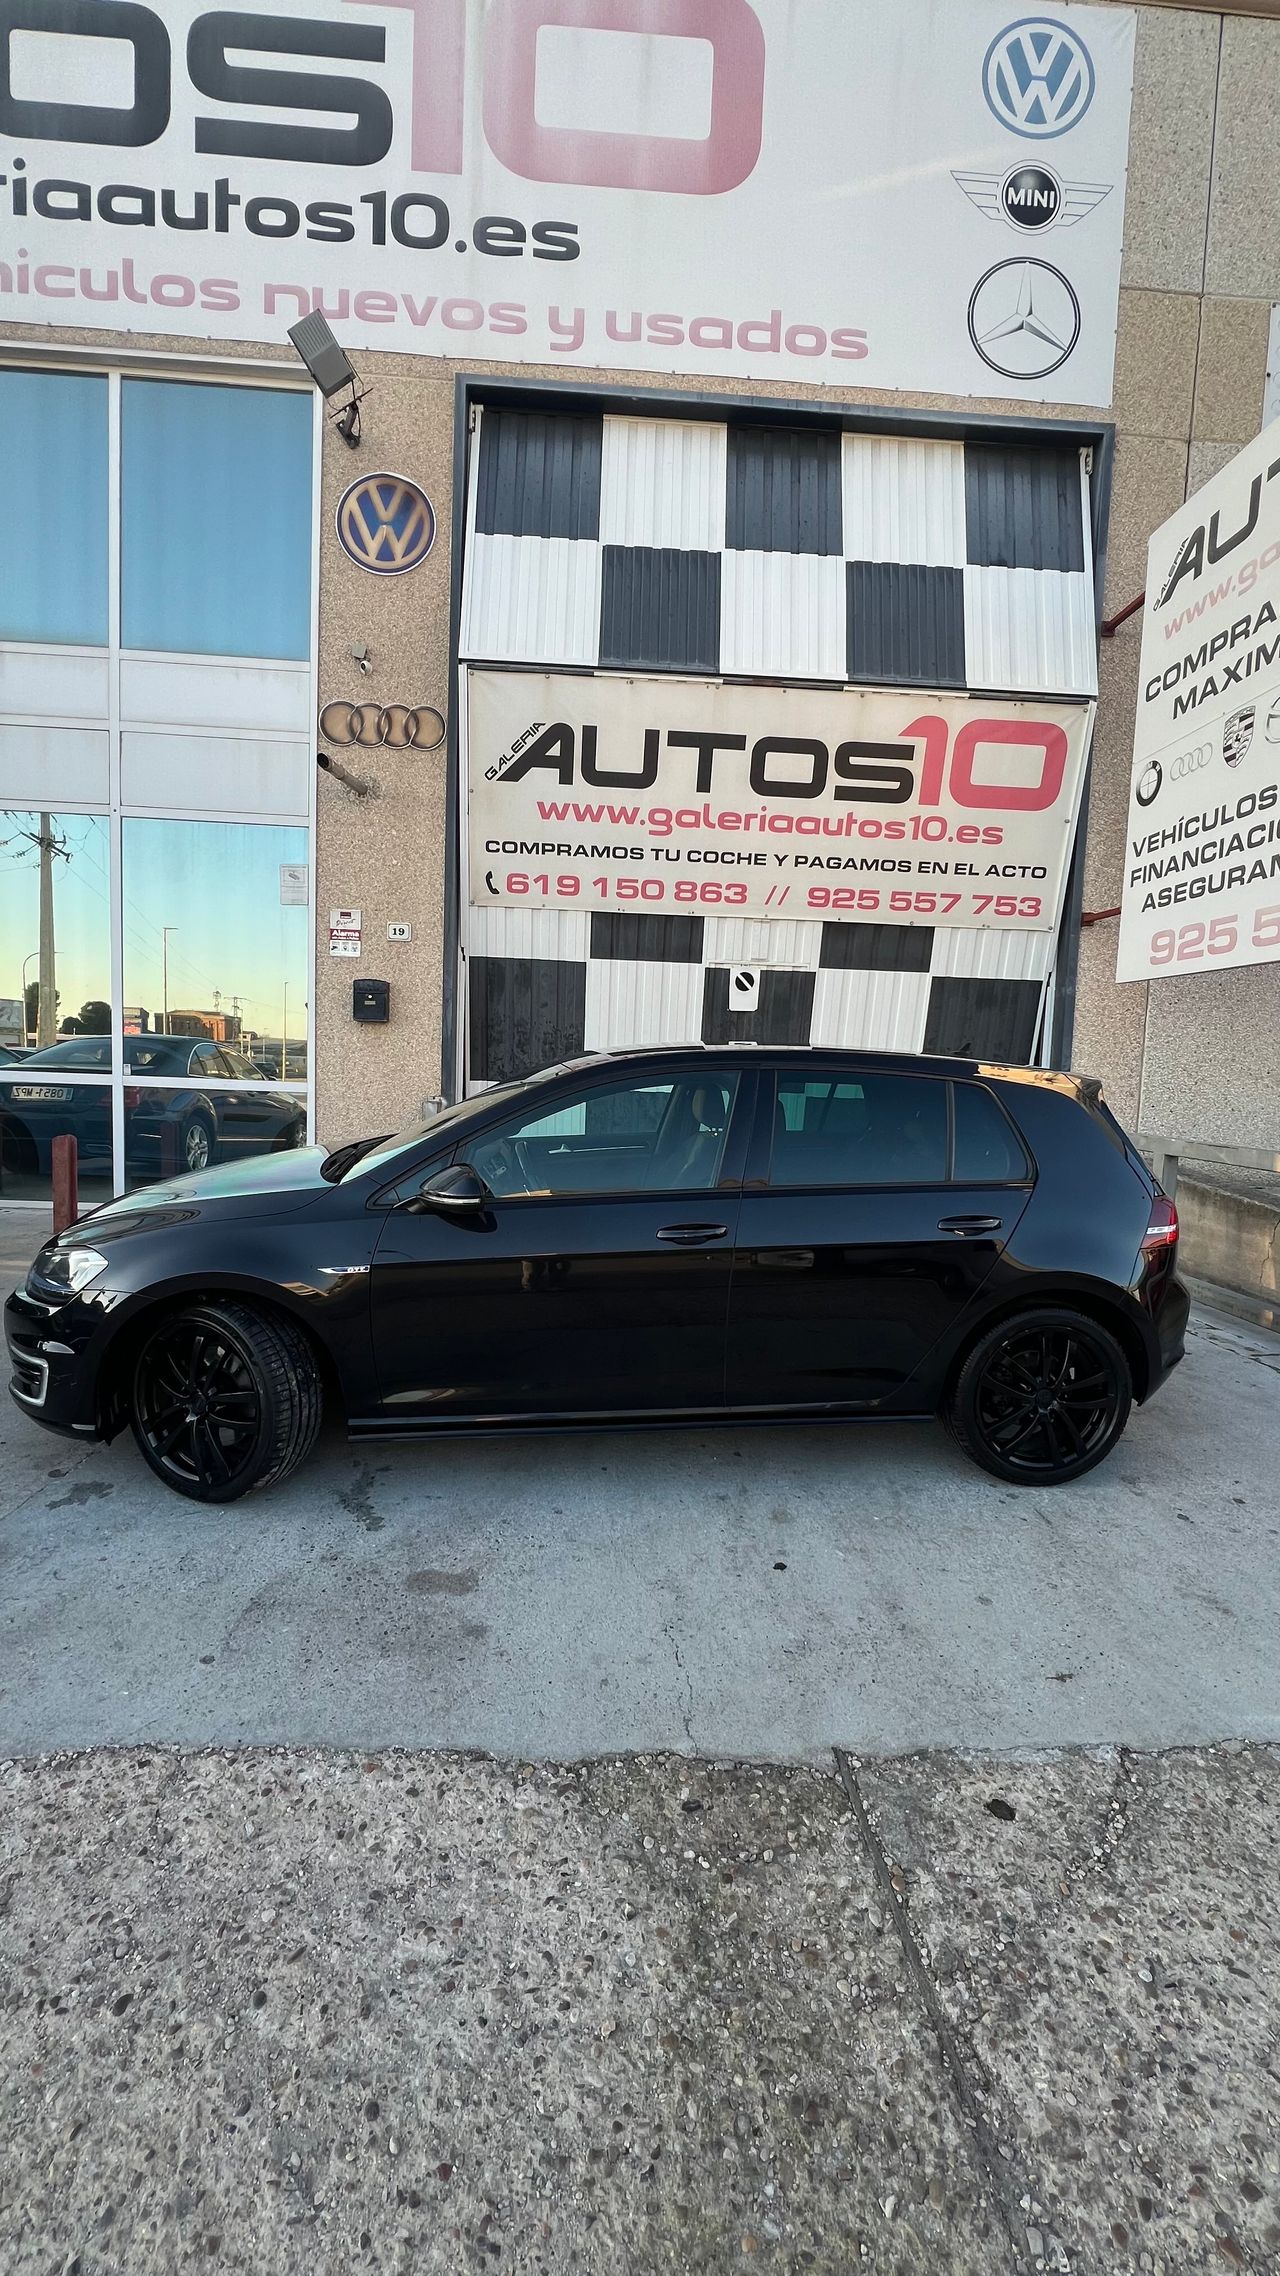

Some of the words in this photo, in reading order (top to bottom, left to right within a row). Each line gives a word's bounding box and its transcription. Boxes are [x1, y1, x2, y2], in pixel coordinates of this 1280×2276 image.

[0, 157, 580, 261] iaautos10.es
[1007, 187, 1056, 208] MINI
[264, 281, 528, 335] nuevos
[549, 305, 585, 351] y
[604, 309, 869, 360] usados
[1153, 537, 1189, 612] GALERIA
[1145, 600, 1278, 703] COMPRA
[484, 722, 546, 781] GALERIA
[536, 801, 1004, 845] www.galeriaautos10.es
[1132, 784, 1278, 858] VEHÍCULOS
[485, 840, 645, 860] COMPRAMOS
[650, 848, 681, 862] TU
[687, 850, 768, 866] COCHE
[773, 854, 789, 867] Y
[794, 855, 912, 873] PAGAMOS
[917, 861, 949, 875] EN
[954, 864, 980, 876] EL
[985, 864, 1048, 879] ACTO
[1130, 820, 1280, 888] FINANCIACI
[506, 872, 580, 897] 619
[592, 877, 665, 900] 150
[674, 881, 748, 904] 863
[806, 886, 881, 911] 925
[888, 890, 962, 914] 557
[972, 895, 1042, 917] 753
[392, 927, 405, 936] 19
[1150, 914, 1239, 966] 925
[1251, 904, 1280, 948] 5
